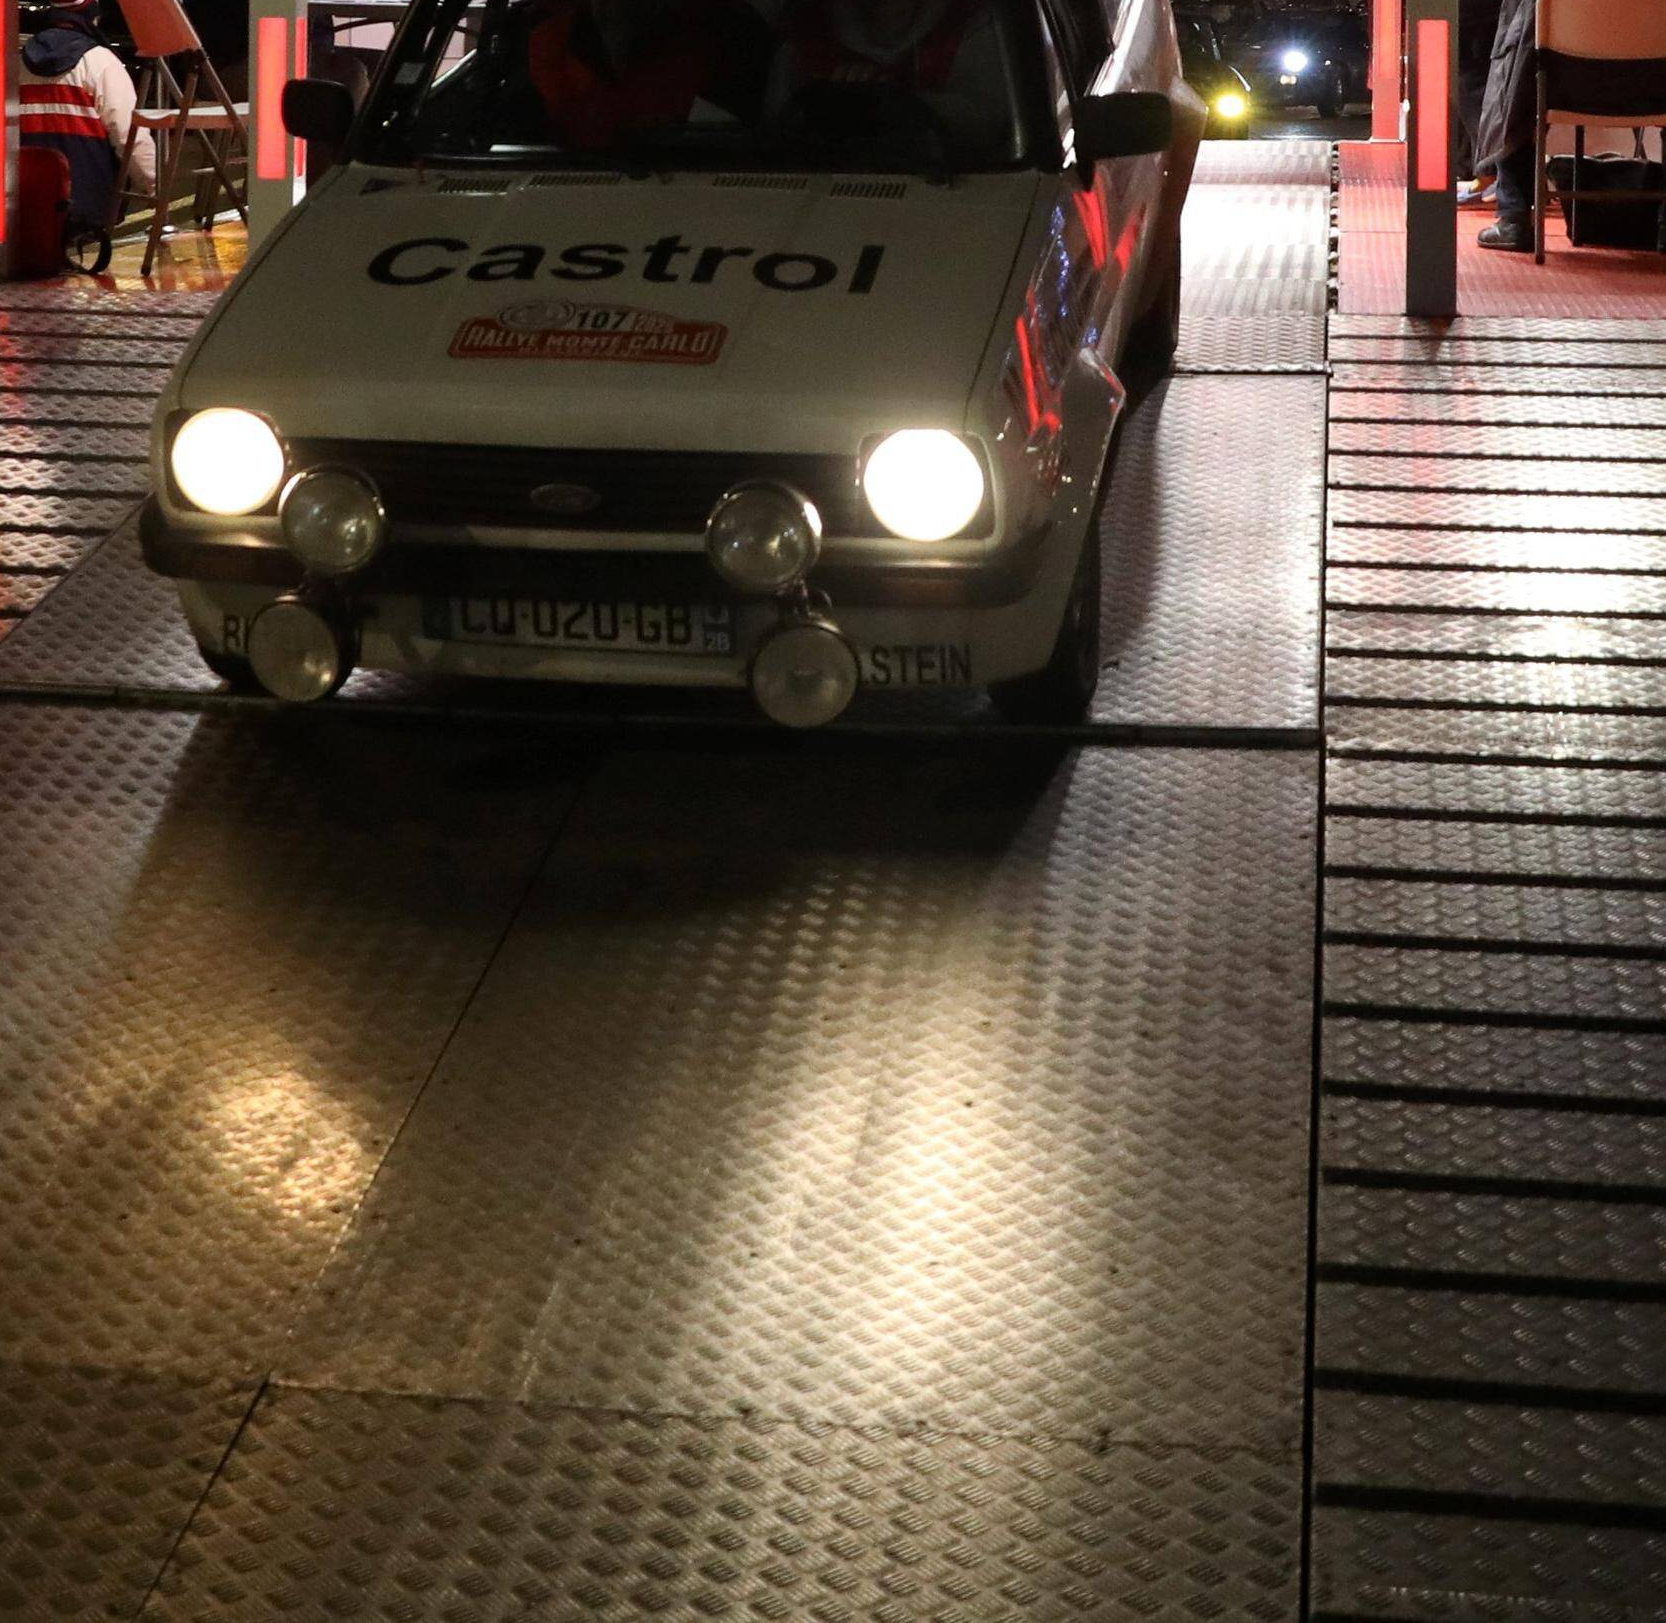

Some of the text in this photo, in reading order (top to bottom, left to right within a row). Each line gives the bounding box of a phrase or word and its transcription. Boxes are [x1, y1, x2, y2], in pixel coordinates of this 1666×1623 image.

[367, 234, 885, 294] Castrol
[577, 310, 630, 329] 107
[464, 325, 537, 348] RALLYE
[861, 644, 973, 685] STEIN
